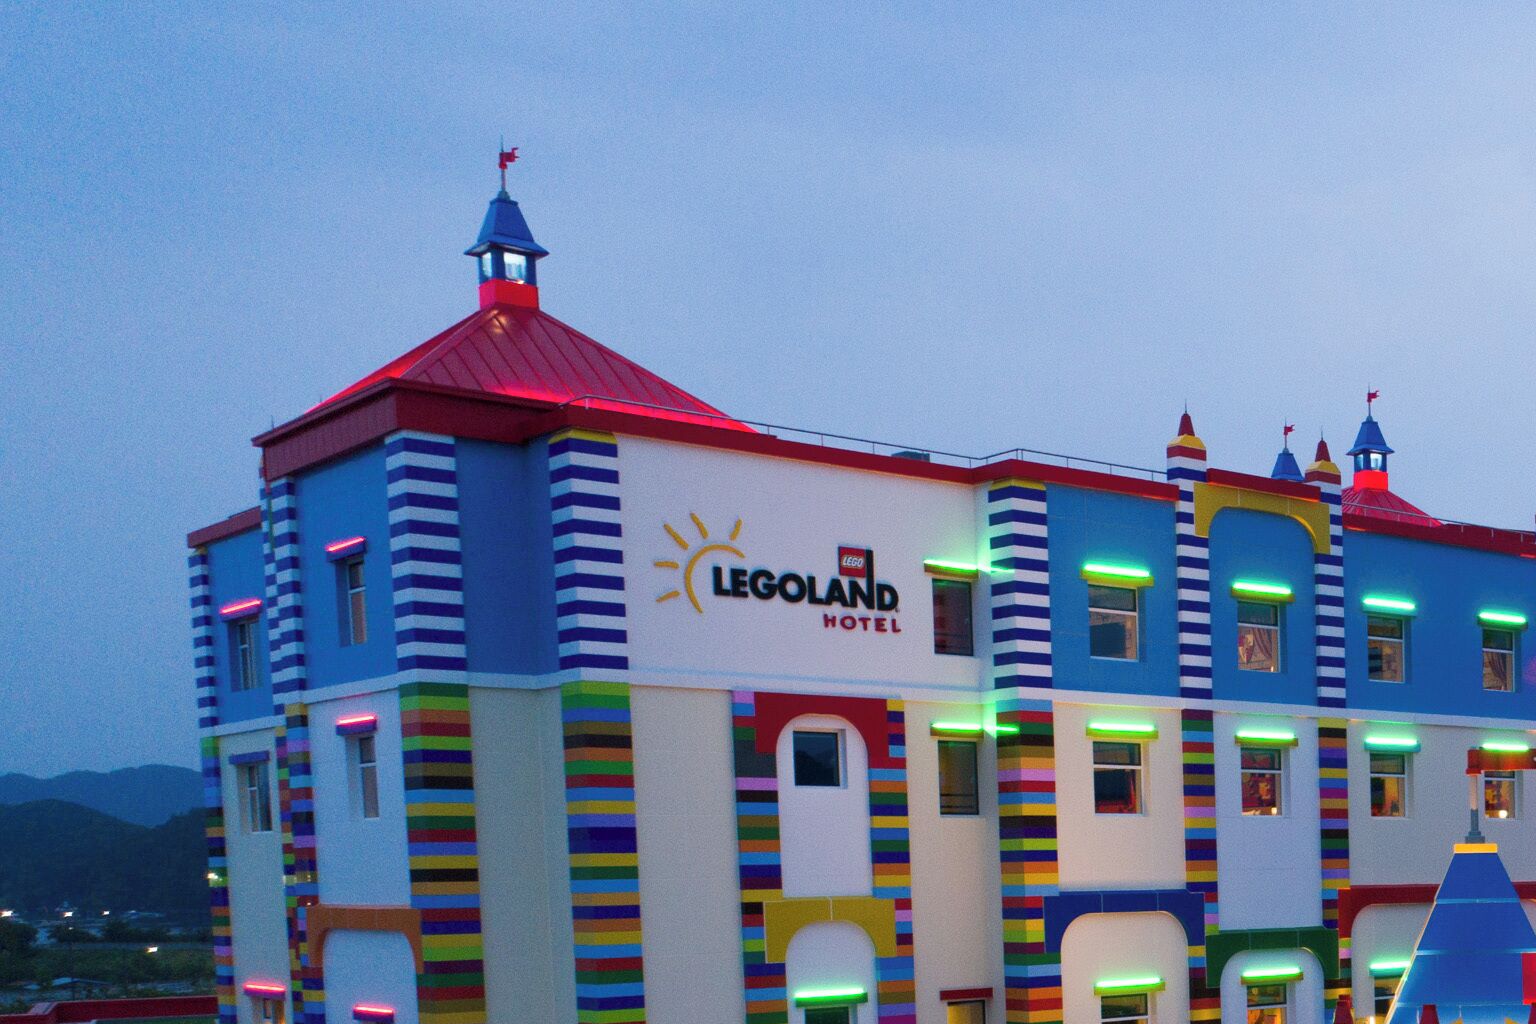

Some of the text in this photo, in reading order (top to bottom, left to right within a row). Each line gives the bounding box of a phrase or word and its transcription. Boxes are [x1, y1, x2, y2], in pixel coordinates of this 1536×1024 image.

[842, 556, 864, 567] LEGO
[713, 548, 899, 611] LEGOLAND
[823, 613, 901, 633] HOTEL
